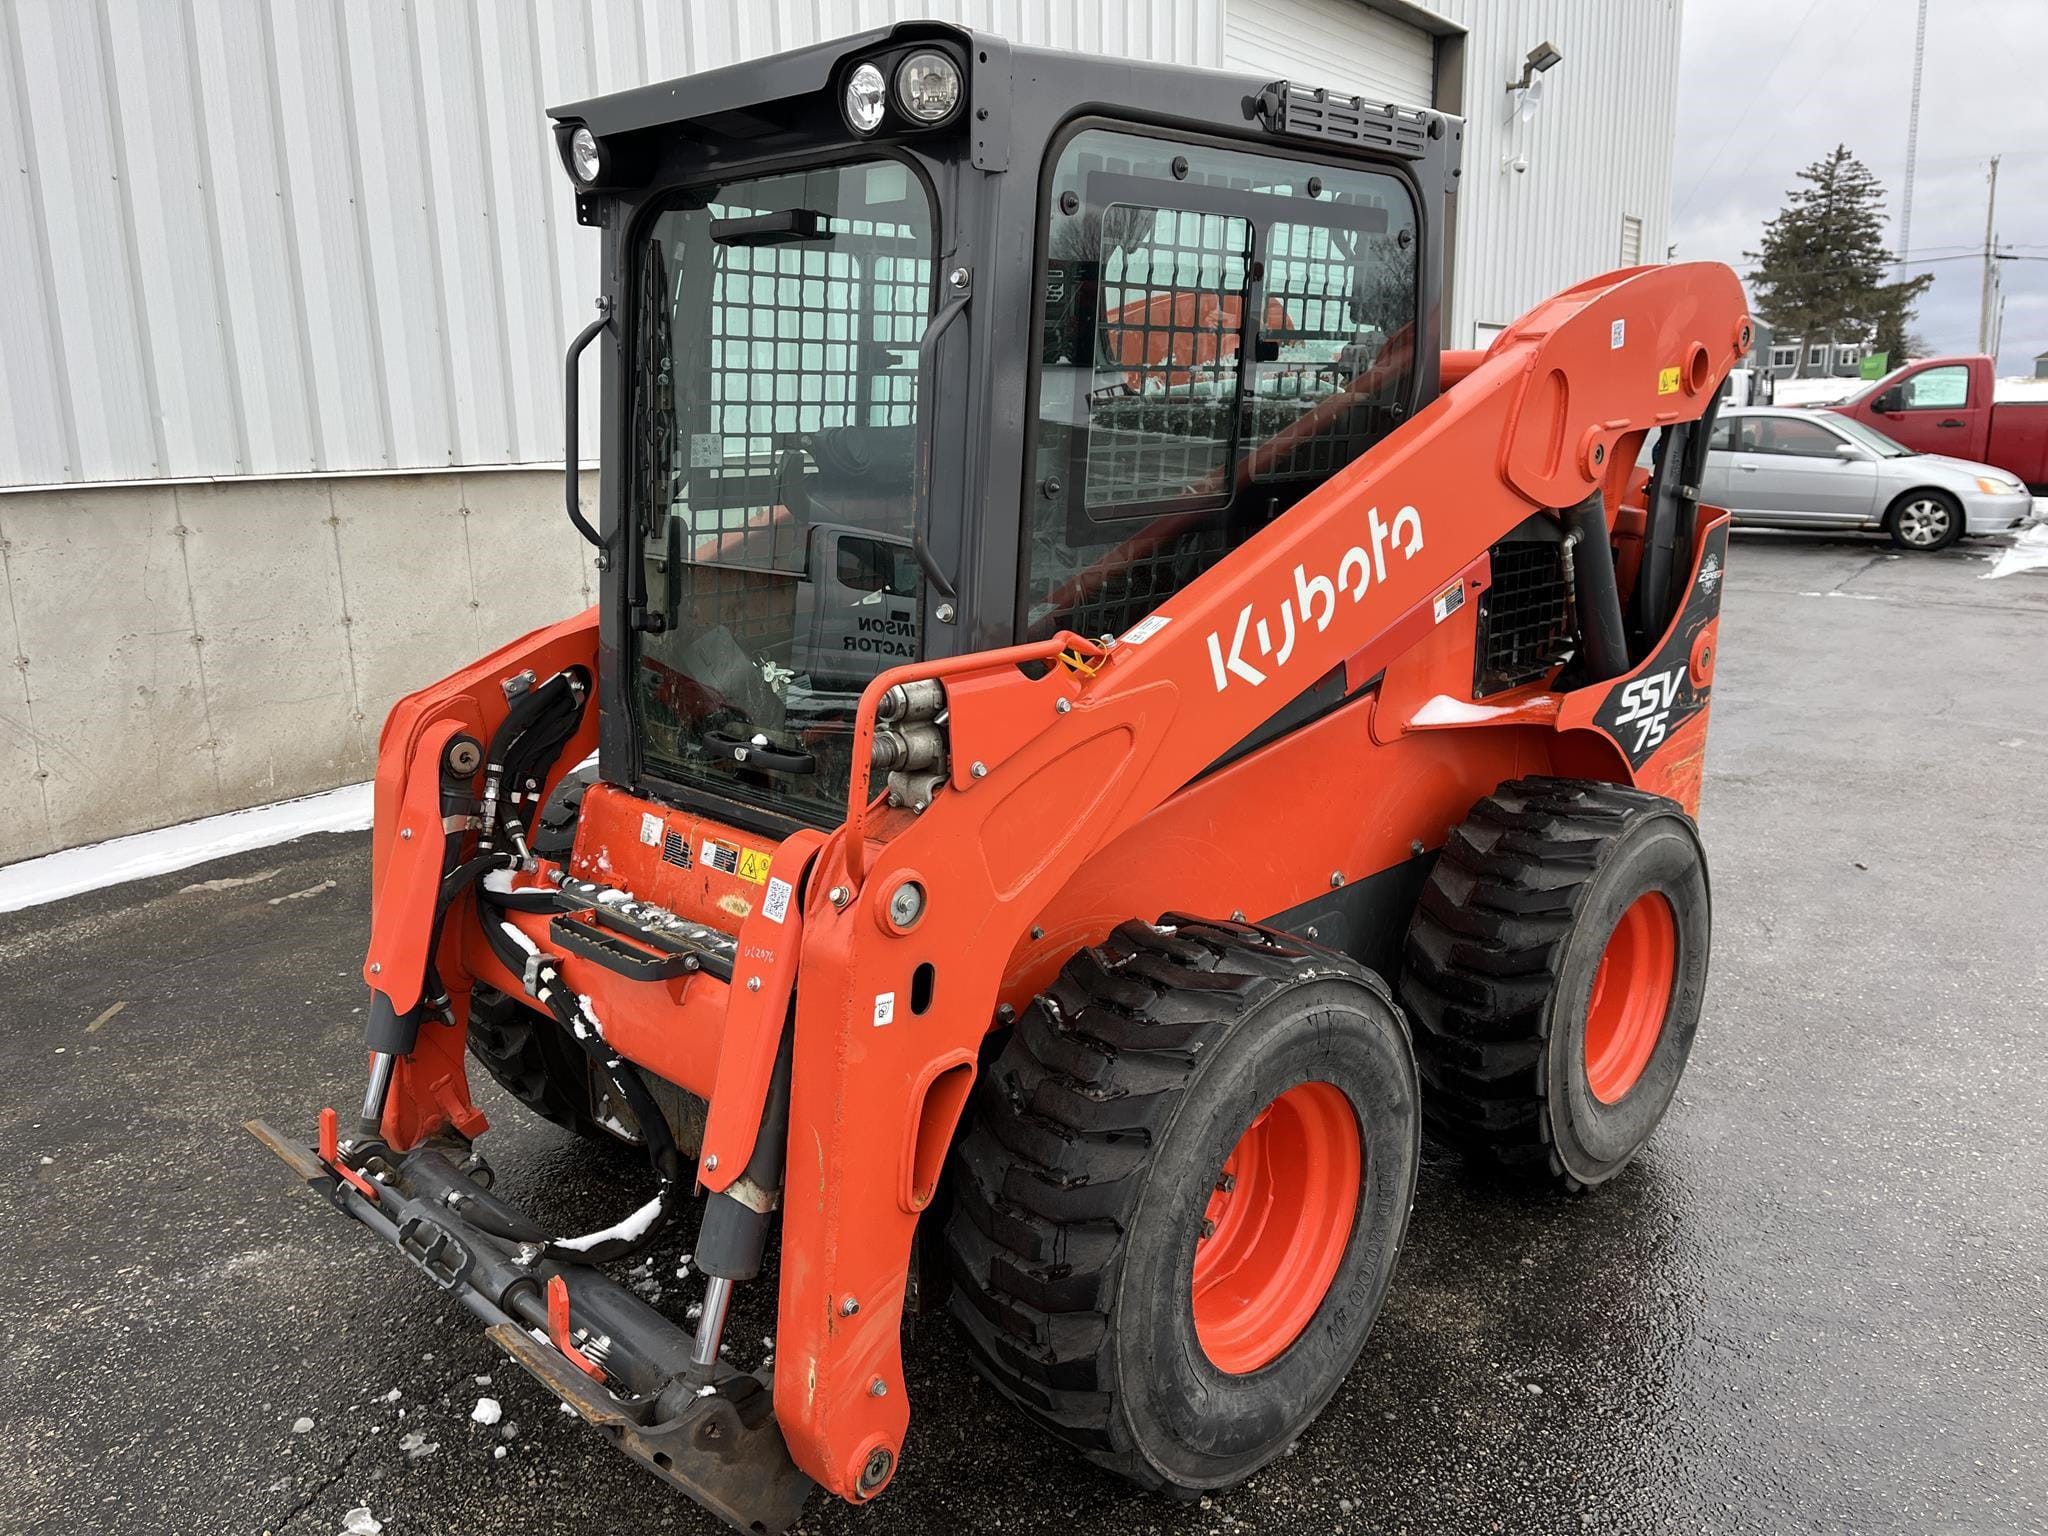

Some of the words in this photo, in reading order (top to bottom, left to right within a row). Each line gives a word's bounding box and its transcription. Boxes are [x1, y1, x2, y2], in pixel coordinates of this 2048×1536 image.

[1206, 505, 1424, 693] Kubota
[1615, 665, 1687, 727] SSV
[1632, 710, 1670, 754] 75
[1350, 1226, 1386, 1308] 2000
